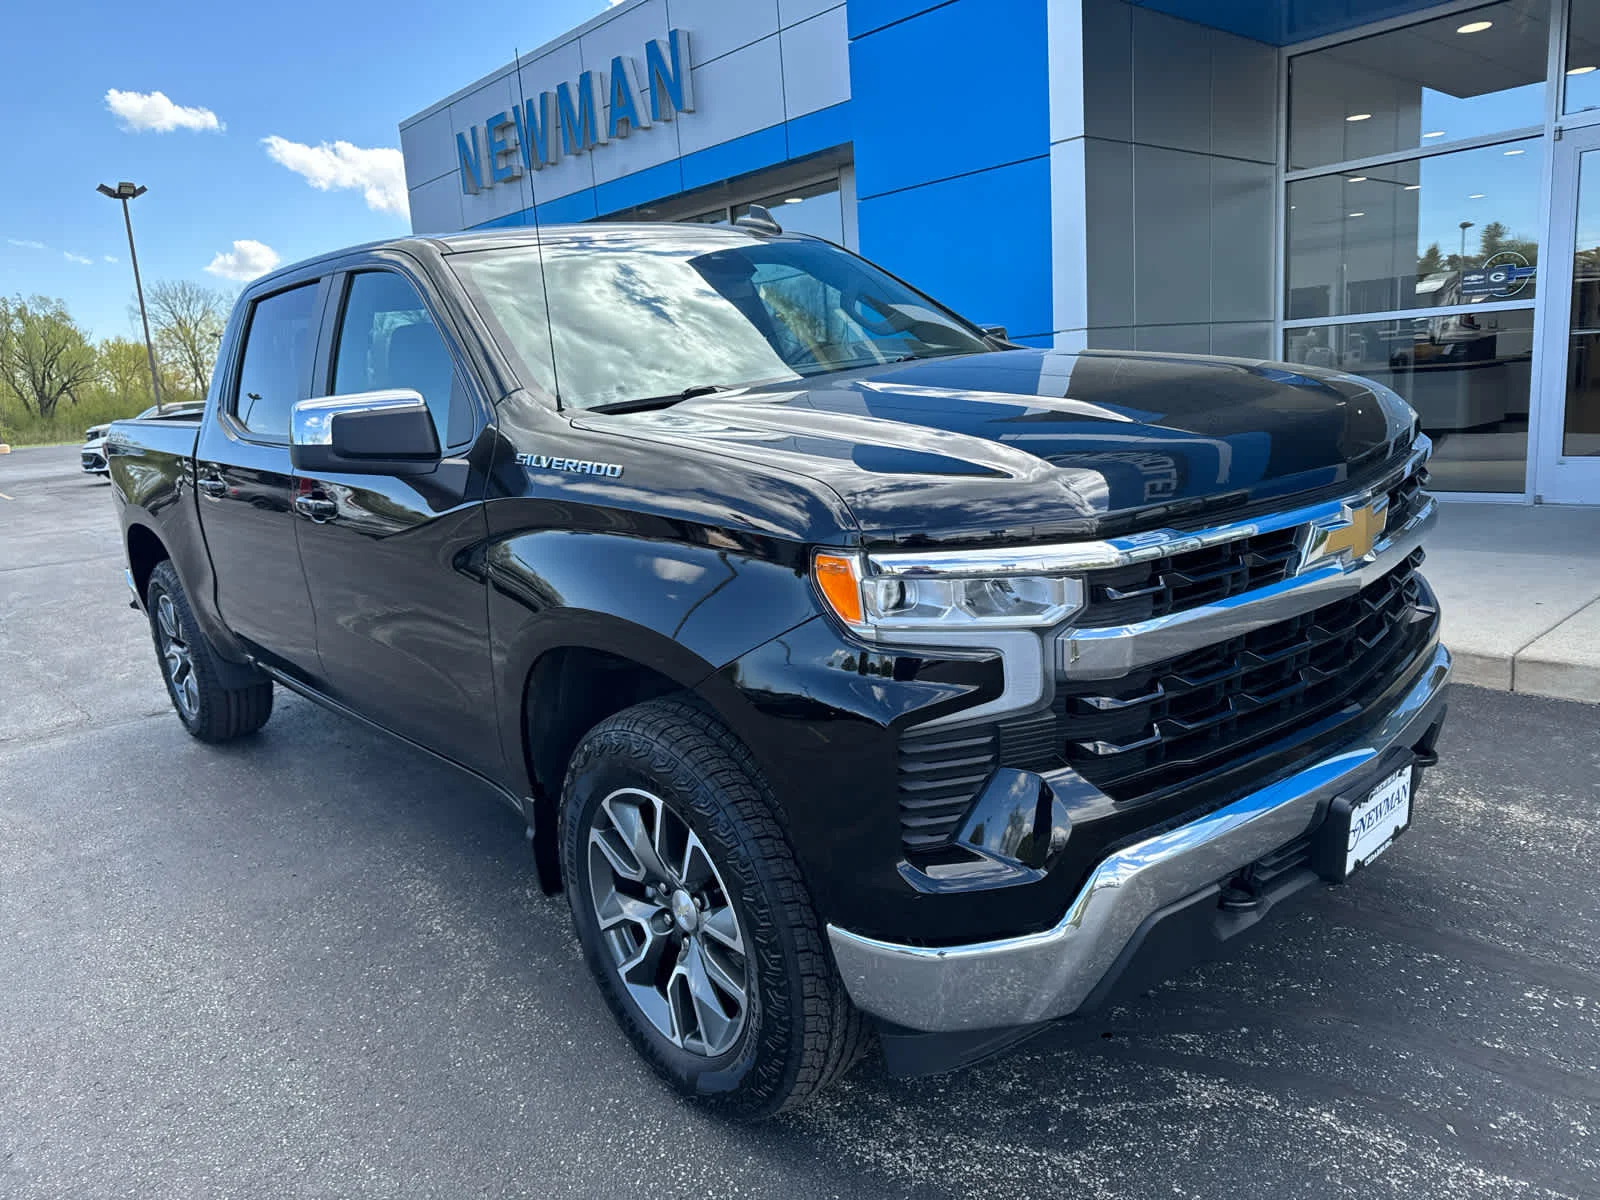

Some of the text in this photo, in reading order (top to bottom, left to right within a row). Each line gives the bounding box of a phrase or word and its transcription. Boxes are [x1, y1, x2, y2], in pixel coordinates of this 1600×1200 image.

[456, 28, 695, 195] NEWMAN
[514, 452, 624, 478] SILVERADO
[1357, 781, 1409, 834] NEWMAN
